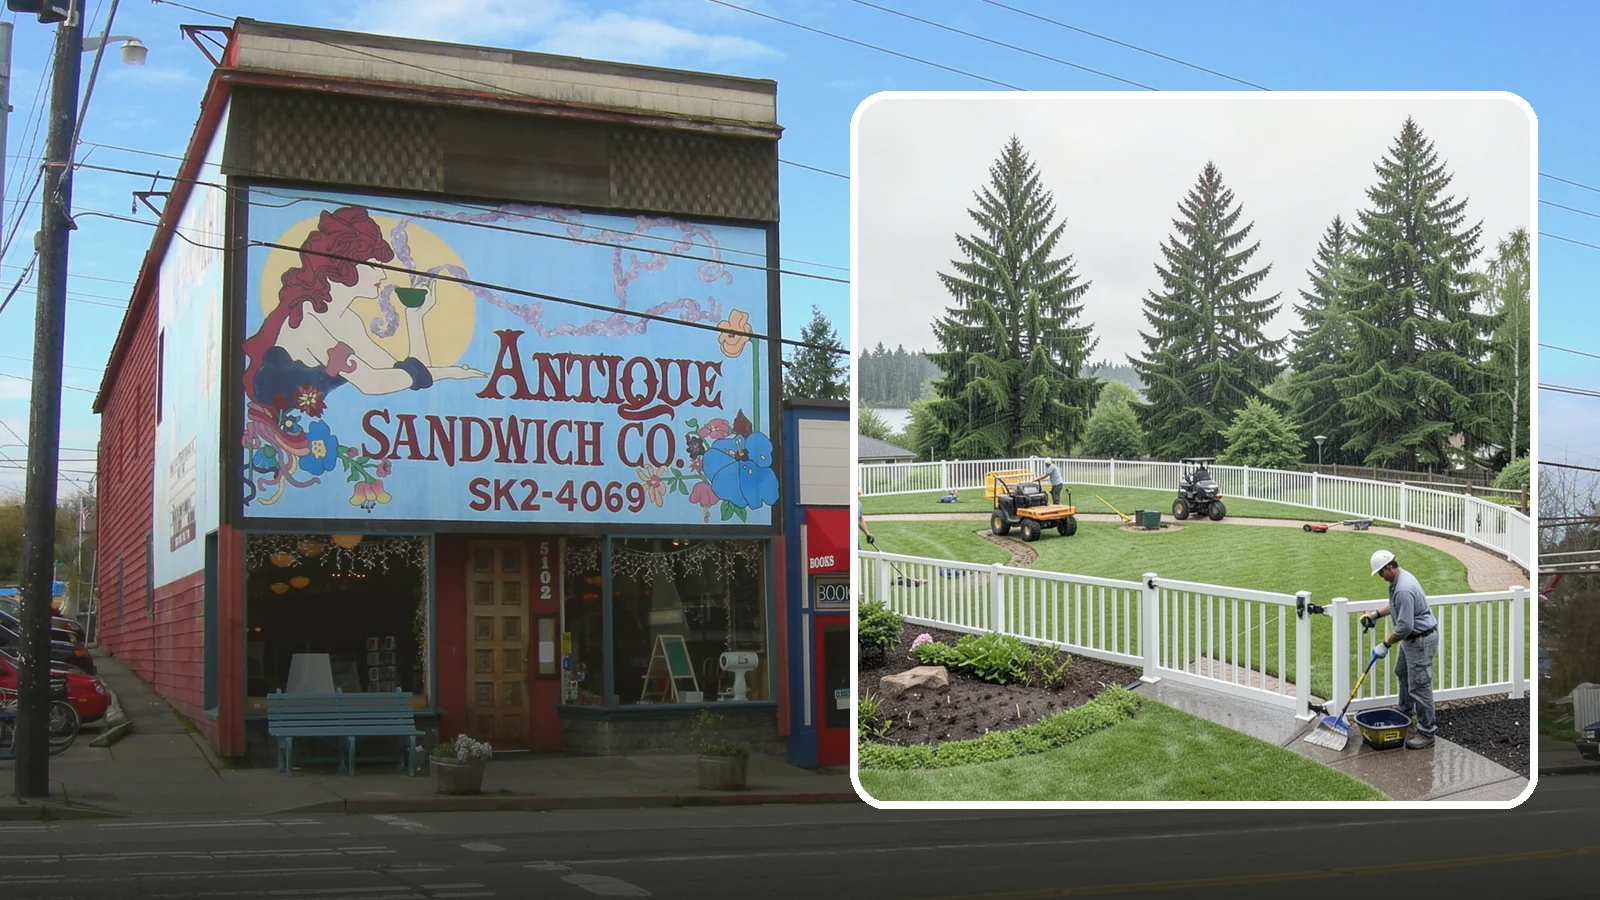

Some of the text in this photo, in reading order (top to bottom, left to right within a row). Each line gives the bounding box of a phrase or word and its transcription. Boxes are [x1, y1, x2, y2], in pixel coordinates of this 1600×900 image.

[476, 329, 723, 421] ANTIQUE
[361, 408, 685, 469] SANDWICH CO.
[468, 478, 645, 512] SK2-4069
[539, 541, 552, 600] 5102
[809, 555, 835, 569] BOOKS
